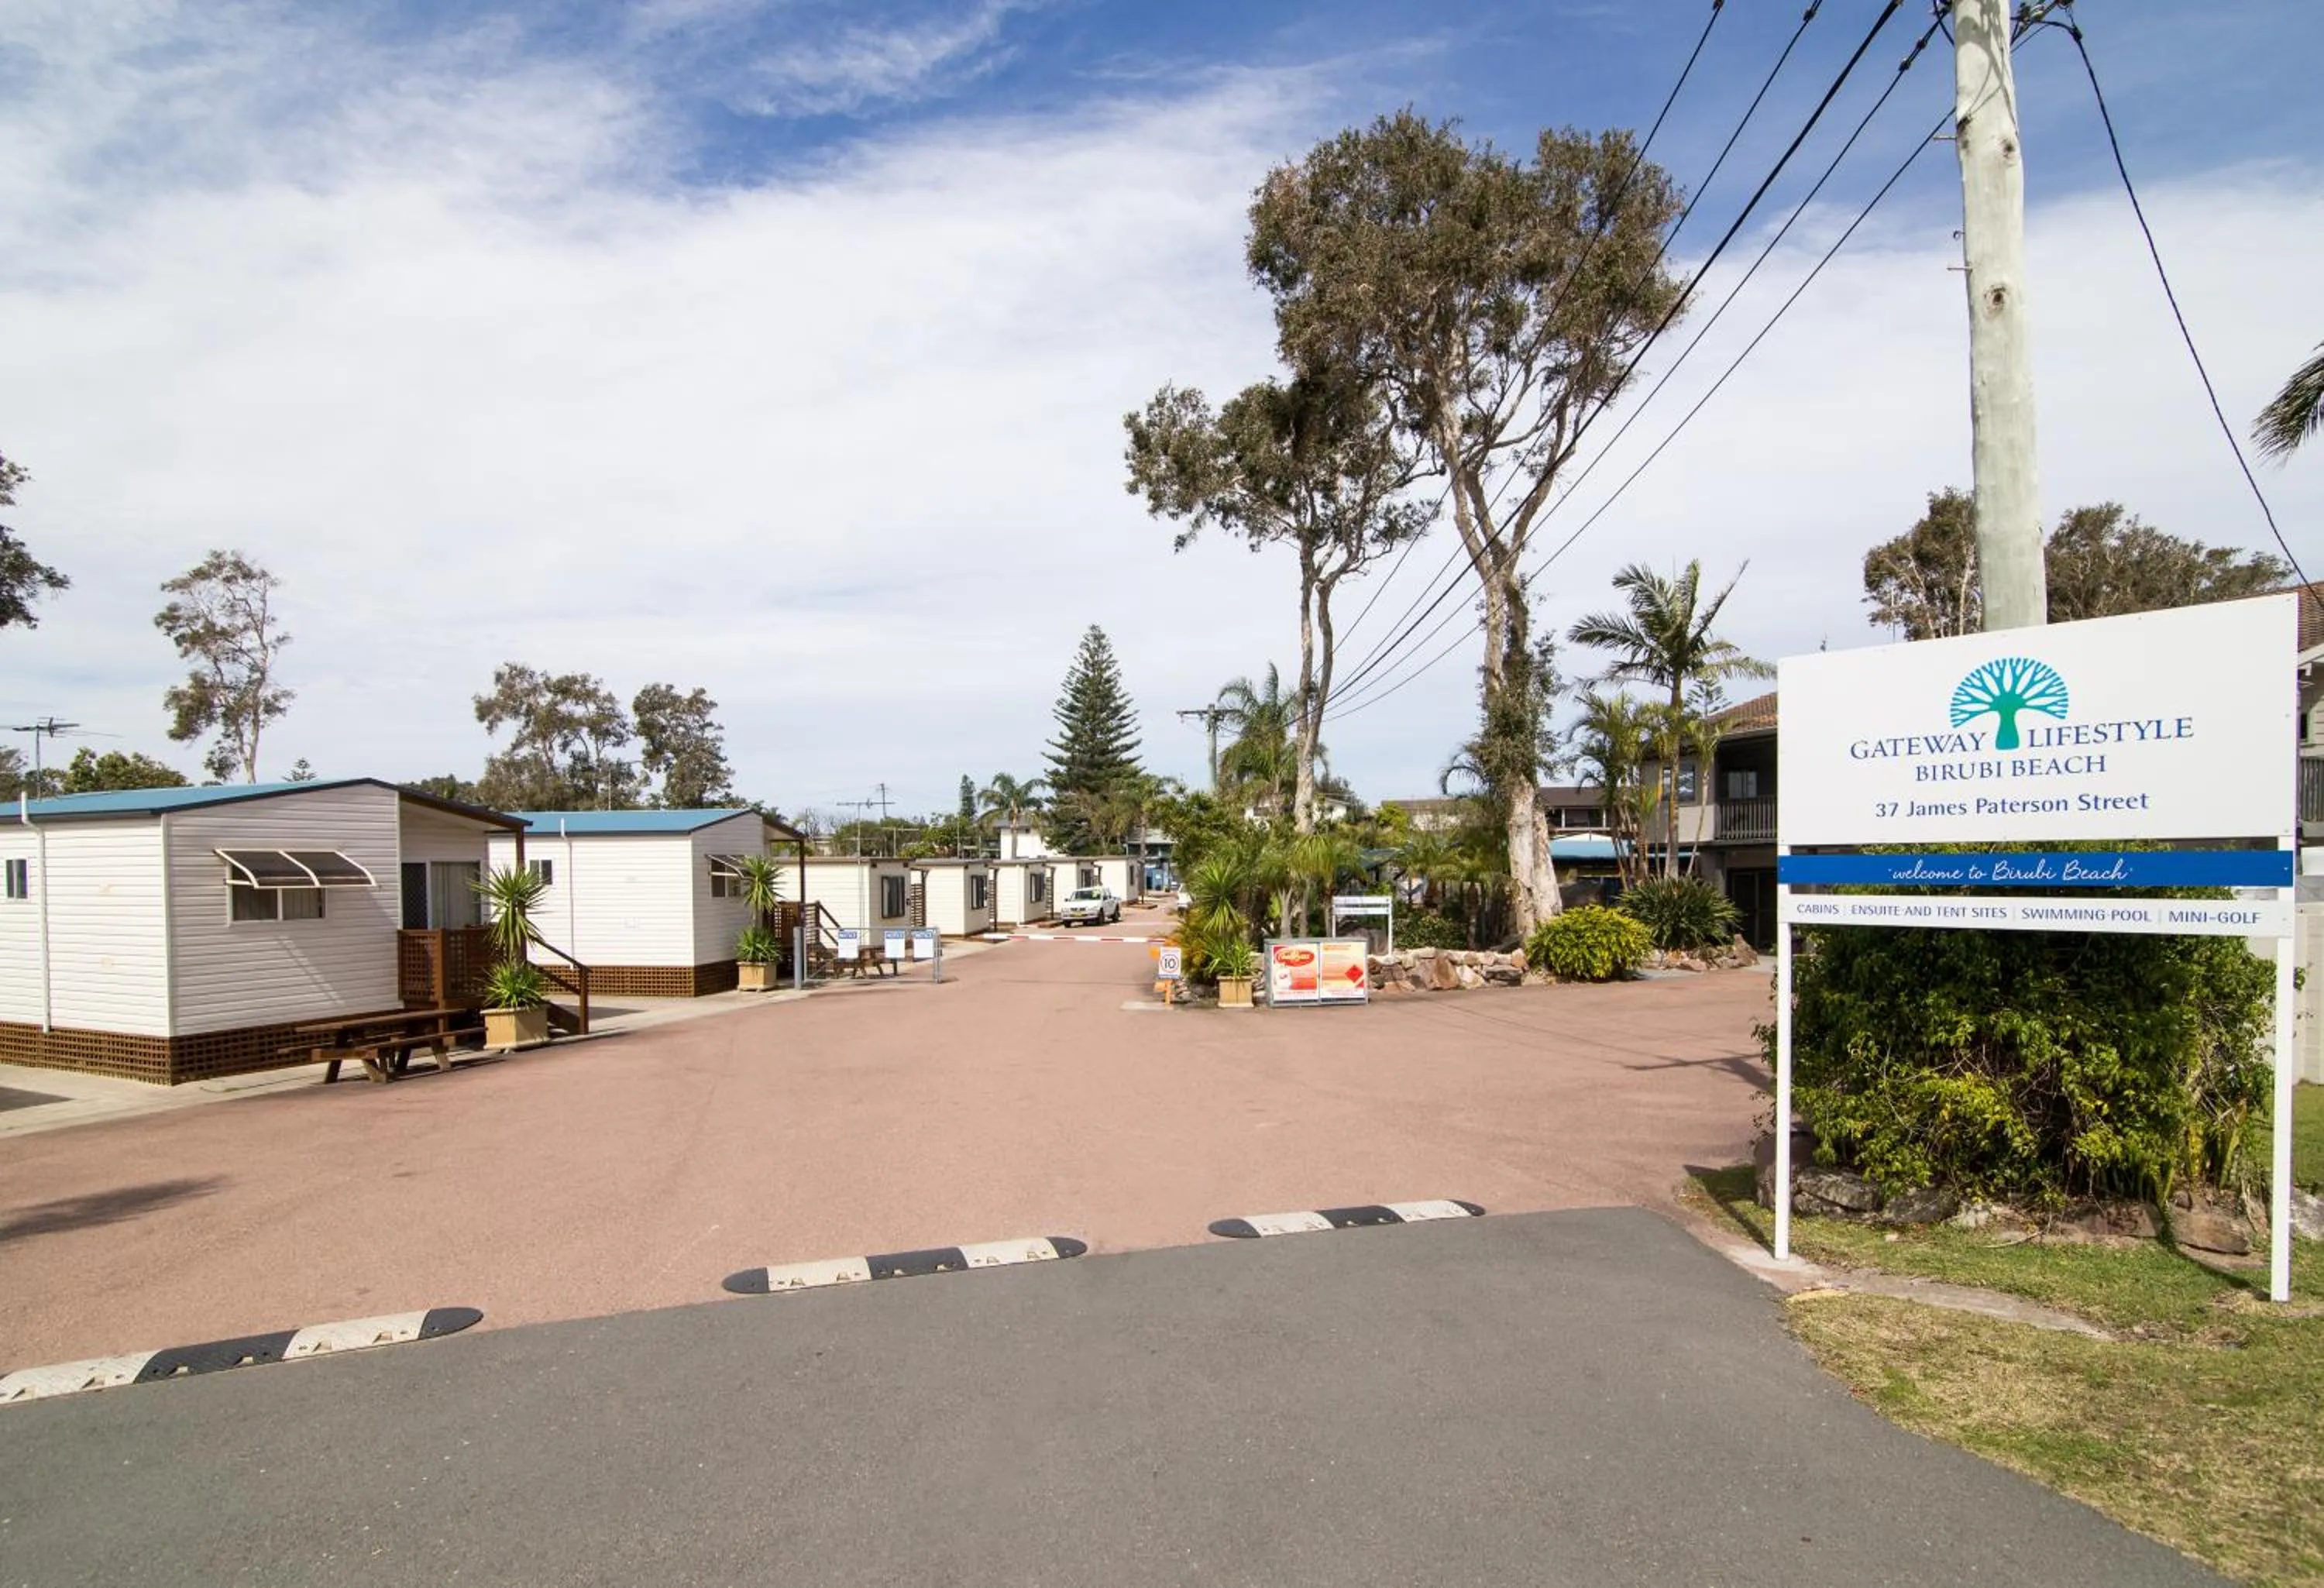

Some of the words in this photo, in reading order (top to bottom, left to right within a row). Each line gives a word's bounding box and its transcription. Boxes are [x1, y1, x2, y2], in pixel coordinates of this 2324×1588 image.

[1850, 732, 1986, 759] GATEWAY
[2028, 717, 2195, 748] LIFESTYLE
[1916, 760, 2002, 782] BIRUBI
[2012, 754, 2107, 777] BEACH
[1875, 803, 1899, 817] 37
[1906, 800, 1968, 817] James
[1975, 797, 2069, 814] Paterson
[2078, 792, 2150, 812] Street
[1893, 858, 1964, 879] welcome
[1968, 864, 1987, 879] to
[1992, 858, 2057, 881] Birubi
[2062, 858, 2129, 881] Beach
[1796, 903, 1840, 915] CABINS
[1851, 904, 1900, 916] ENSUITE
[1905, 906, 1932, 916] AND
[1937, 906, 1967, 918] TENT
[1972, 907, 2008, 919] SITES
[2020, 907, 2106, 921] SWIMMING
[2110, 909, 2152, 922] POOL
[2168, 910, 2261, 924] MINI-GOLF
[1164, 958, 1176, 968] 10
